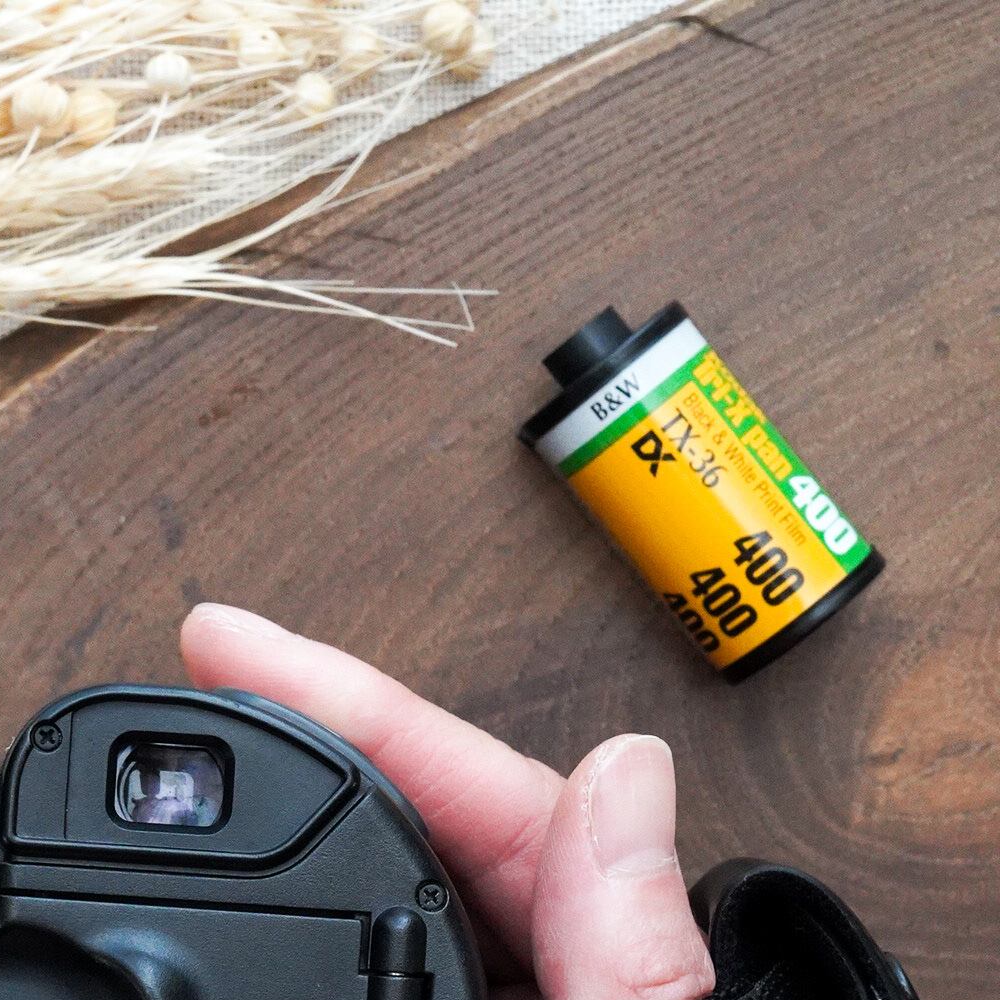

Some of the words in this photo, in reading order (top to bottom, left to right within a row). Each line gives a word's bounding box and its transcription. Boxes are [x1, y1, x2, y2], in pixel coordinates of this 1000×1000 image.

[590, 371, 640, 421] B&W
[661, 407, 728, 488] TX-36
[684, 392, 715, 431] Black
[712, 430, 727, 446] &
[724, 444, 759, 484] White
[753, 480, 784, 516] Print
[779, 512, 807, 547] Film
[740, 425, 793, 482] pan
[789, 475, 859, 556] 400
[690, 567, 758, 638] 400
[733, 530, 805, 607] 400
